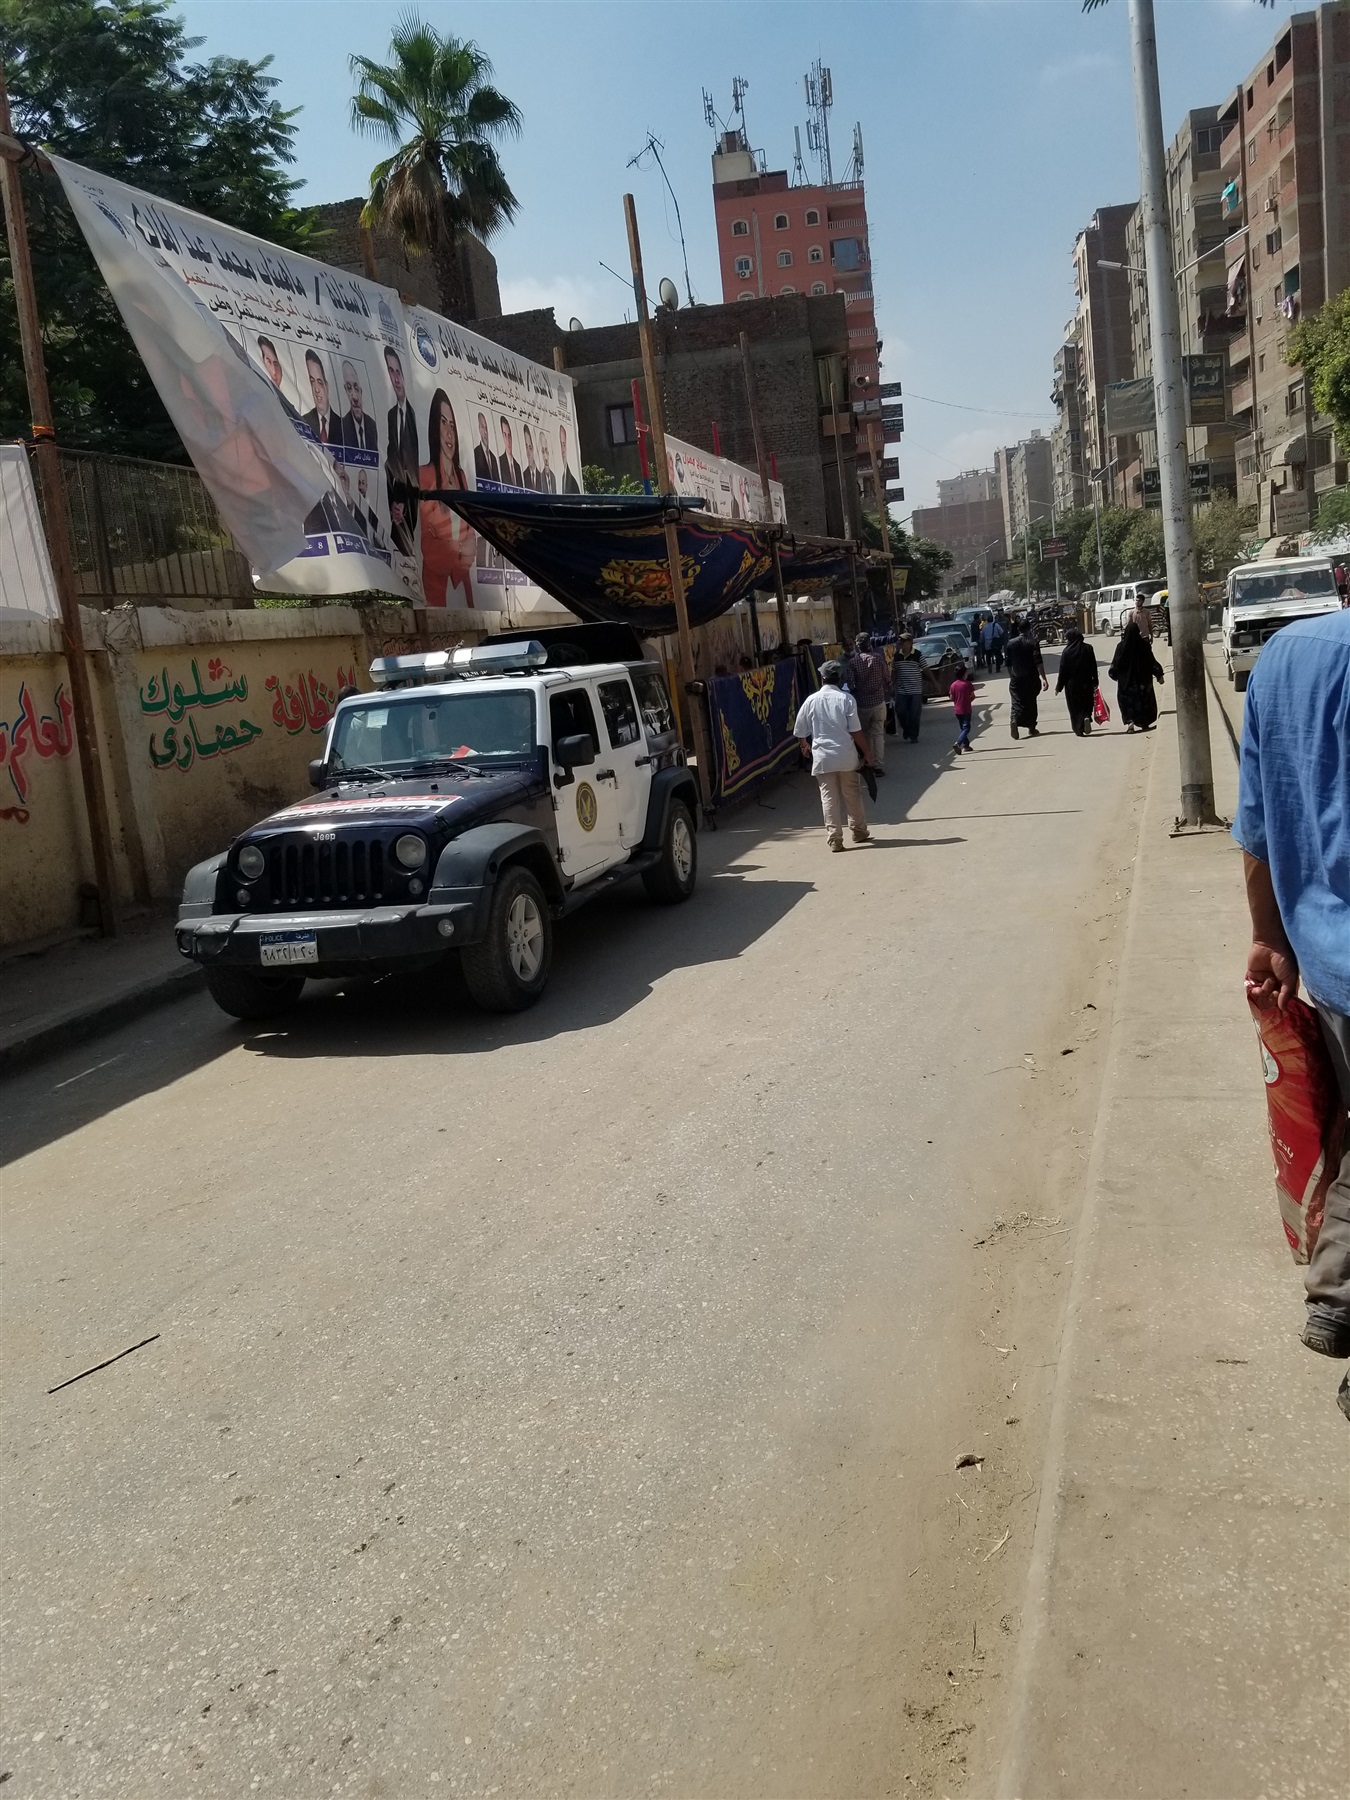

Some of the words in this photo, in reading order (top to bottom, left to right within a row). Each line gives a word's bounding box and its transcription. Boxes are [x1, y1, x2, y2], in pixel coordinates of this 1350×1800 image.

[179, 225, 214, 273] عبد
[210, 238, 258, 283] محمد
[209, 294, 235, 316] وطن
[234, 300, 270, 327] مستقبل
[272, 316, 292, 333] حزب
[302, 309, 333, 328] الشباب
[447, 365, 462, 378] وطن
[463, 370, 487, 387] مستقبل
[139, 657, 250, 723] سلوك
[313, 832, 336, 842] Jeep
[264, 934, 284, 942] POLICE
